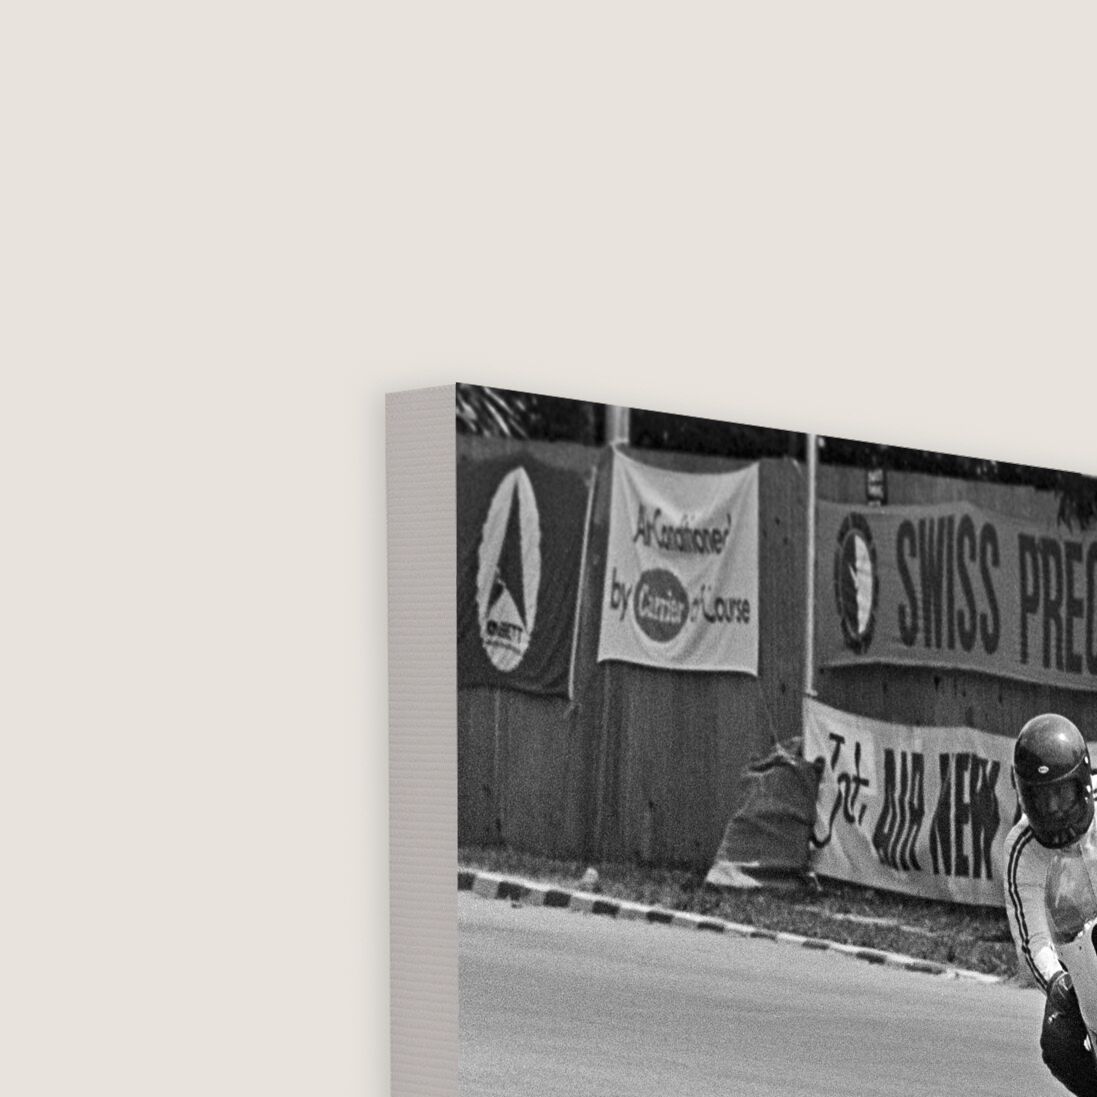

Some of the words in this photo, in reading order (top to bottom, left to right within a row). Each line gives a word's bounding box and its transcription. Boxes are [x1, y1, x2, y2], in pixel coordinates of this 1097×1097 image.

[610, 567, 632, 622] by
[896, 513, 1000, 655] SWISS
[873, 748, 925, 872] AIR
[929, 752, 1001, 881] NEW
